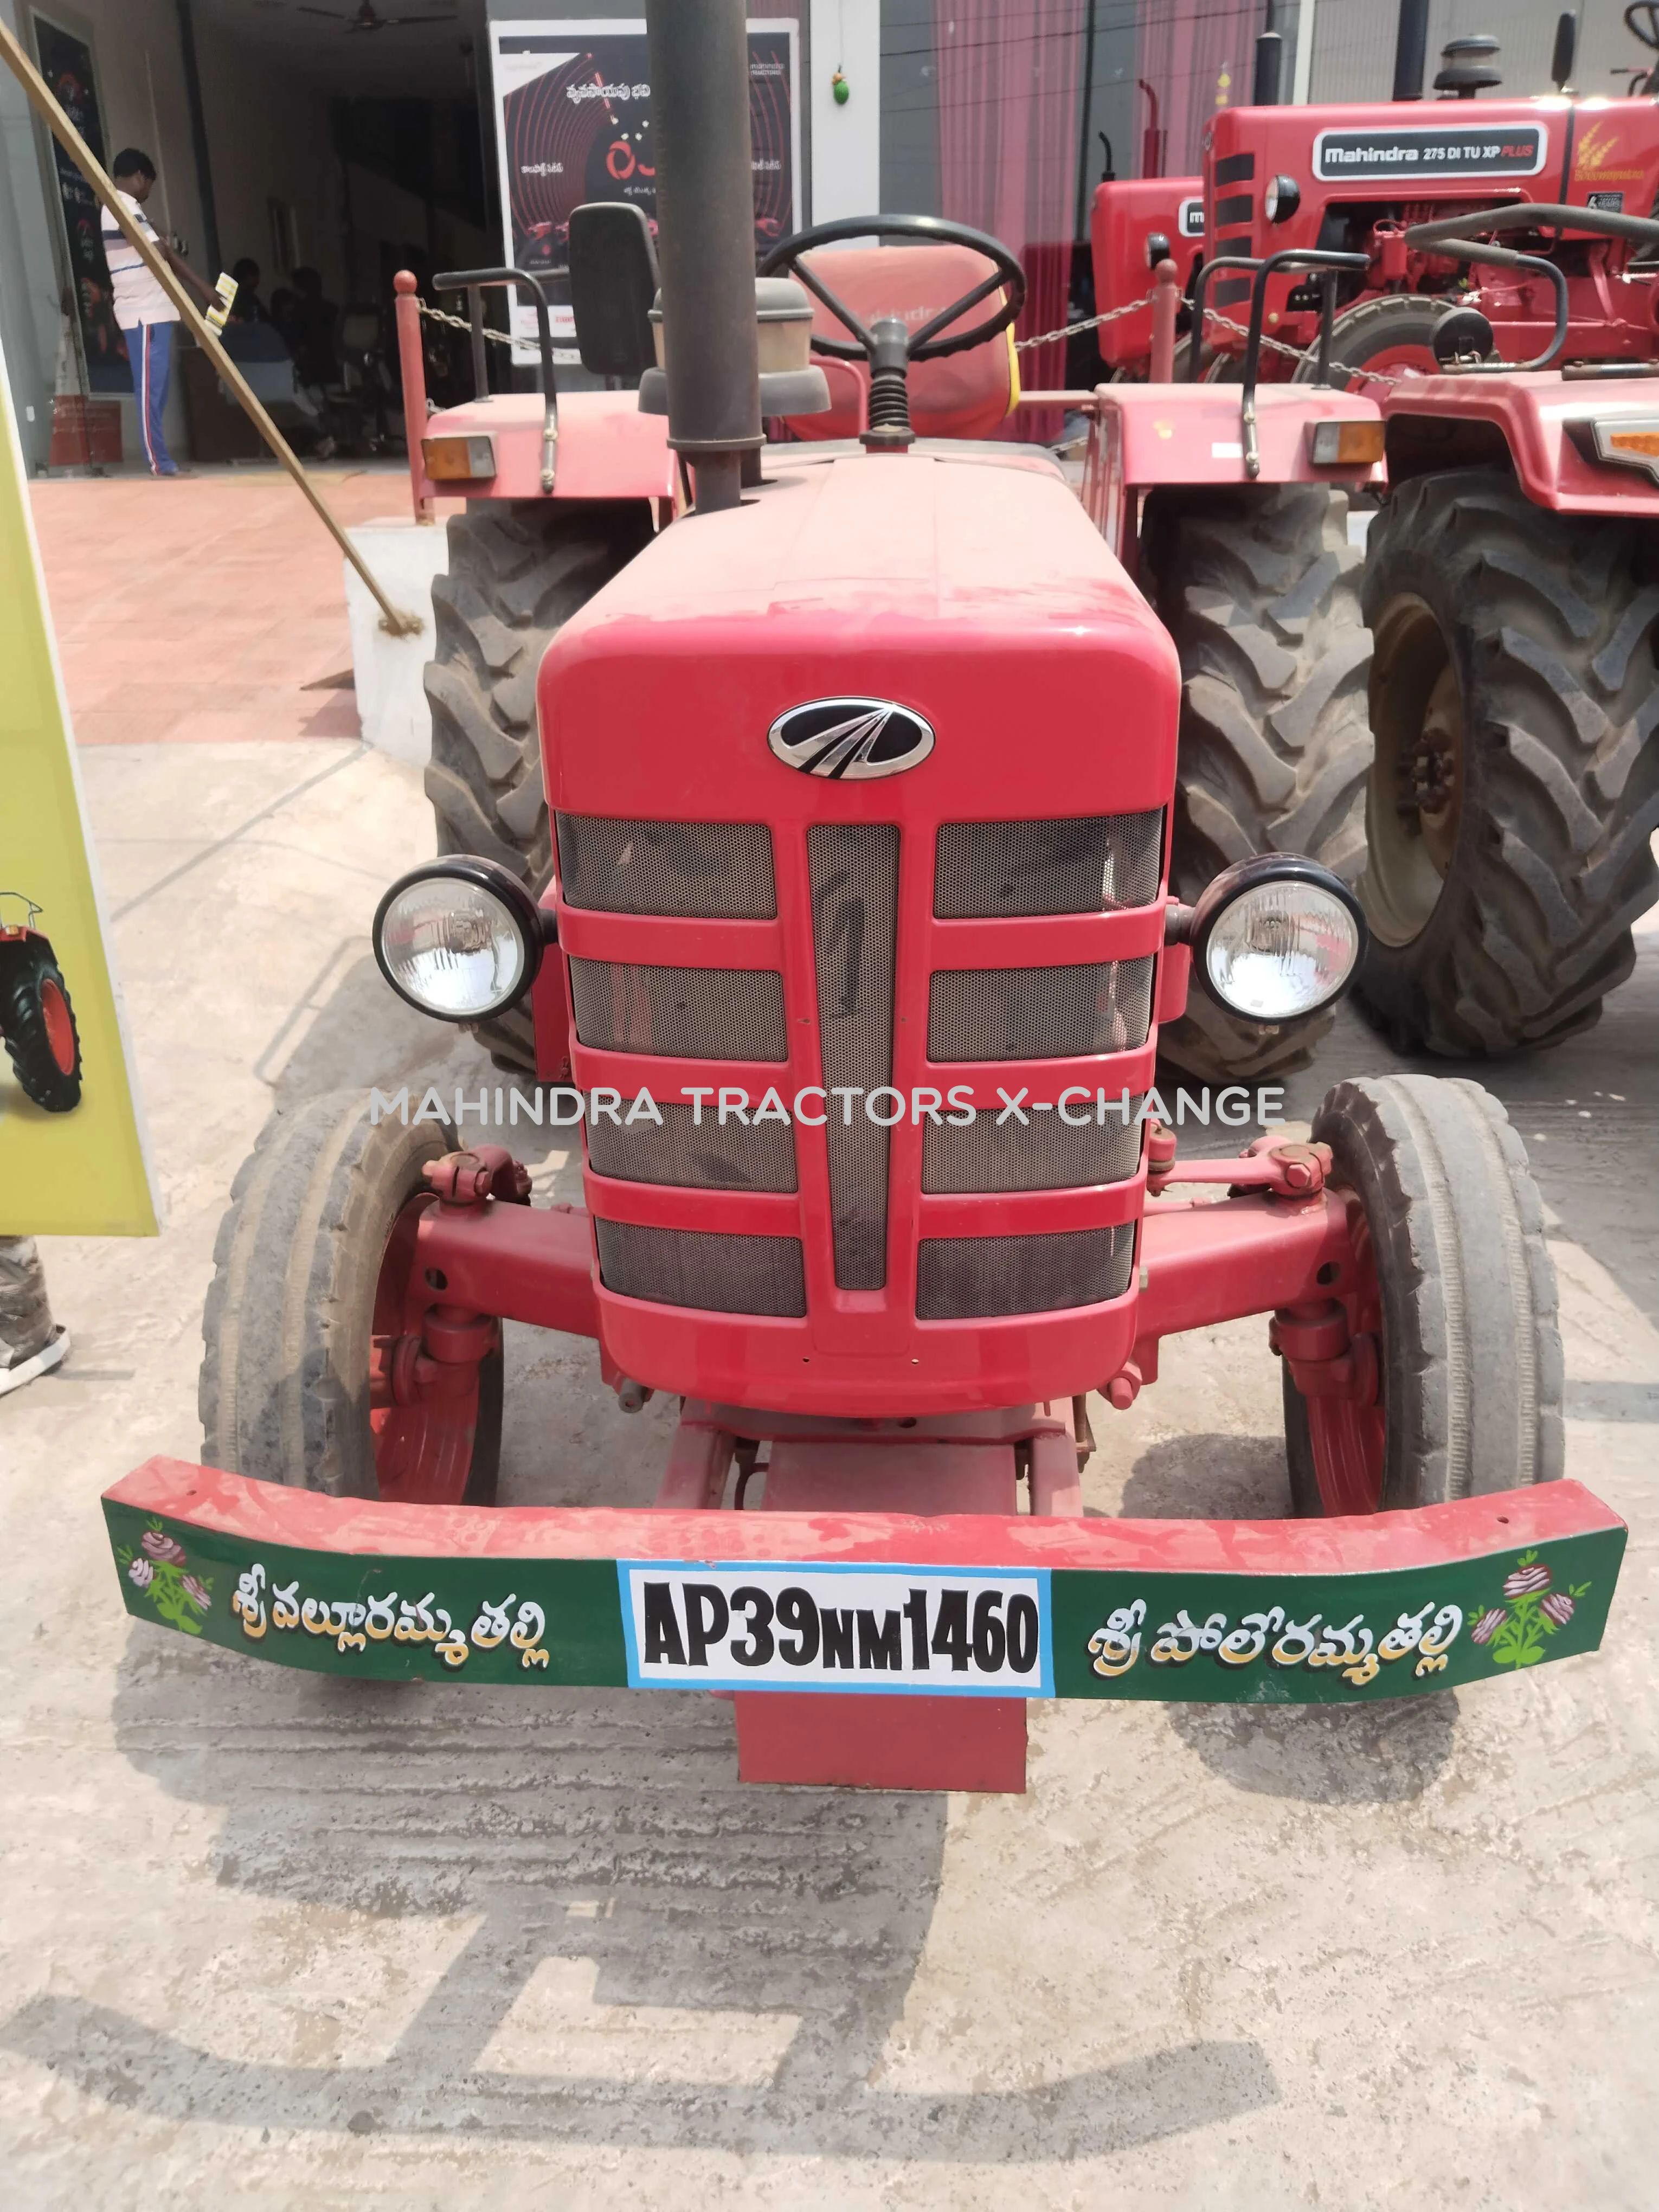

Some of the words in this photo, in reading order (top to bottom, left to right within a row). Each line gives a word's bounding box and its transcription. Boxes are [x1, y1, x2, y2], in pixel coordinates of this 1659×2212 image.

[1325, 146, 1419, 163] Mahindra
[1423, 147, 1446, 160] 275
[1448, 147, 1461, 160] DI
[1463, 146, 1481, 159] TU
[1482, 145, 1501, 159] XP
[1501, 145, 1534, 157] PLUS
[232, 1562, 267, 1638] శ్రీ
[471, 1593, 550, 1669] తల్లి
[1088, 1598, 1147, 1677] శ్రీ
[1378, 1601, 1463, 1677] తల్లి
